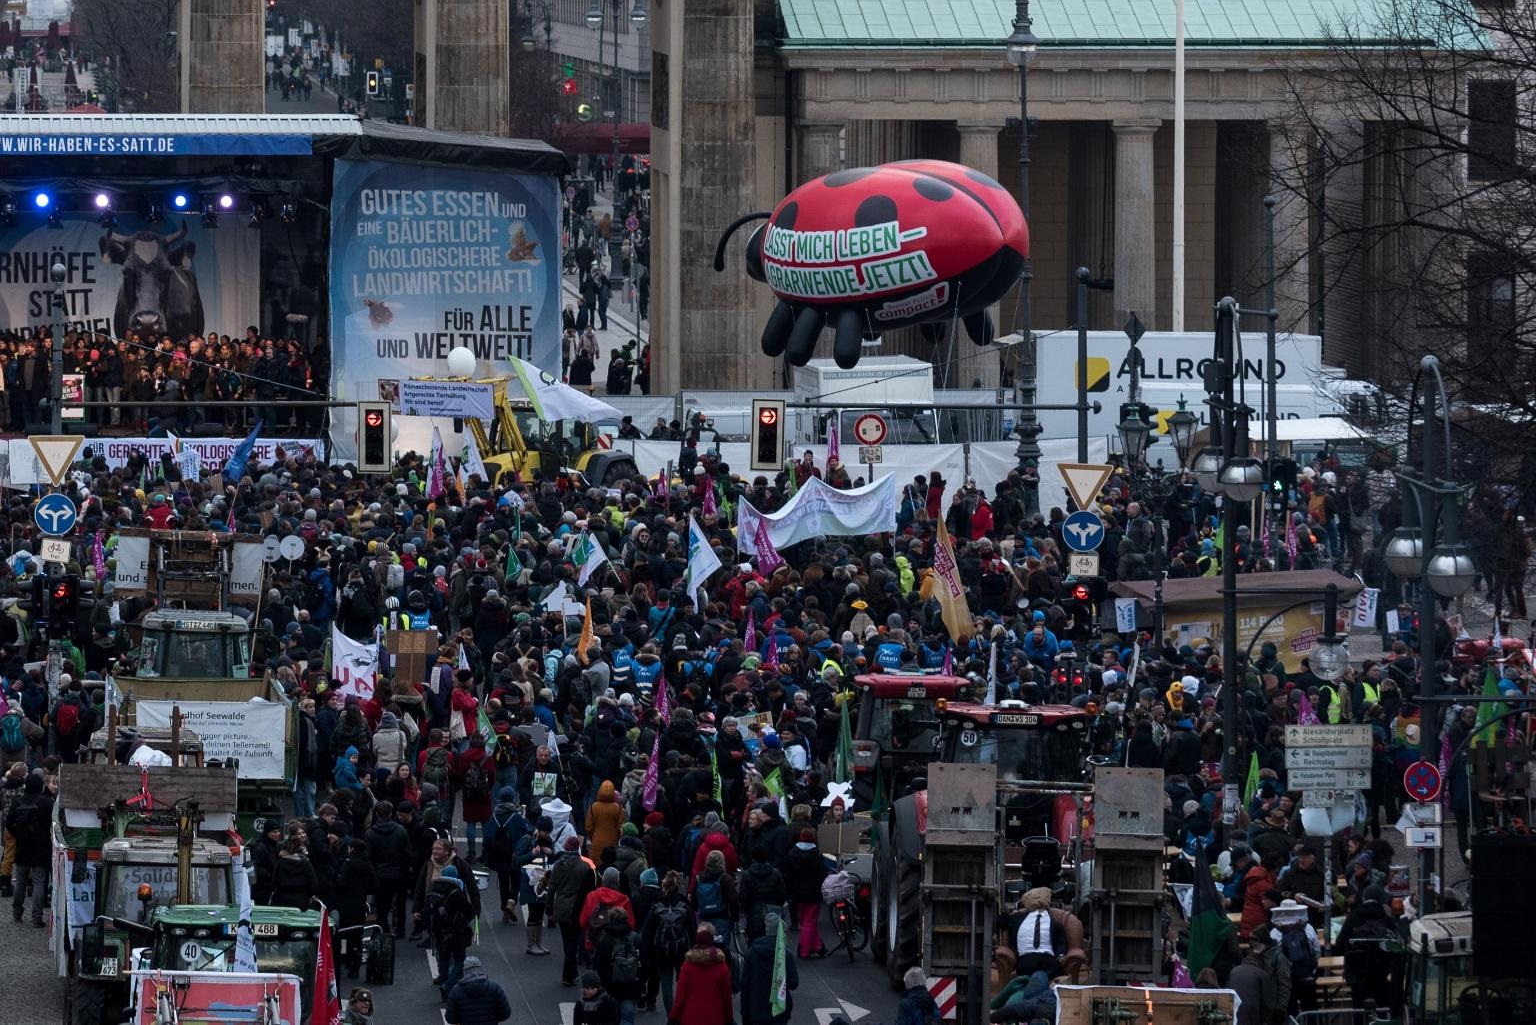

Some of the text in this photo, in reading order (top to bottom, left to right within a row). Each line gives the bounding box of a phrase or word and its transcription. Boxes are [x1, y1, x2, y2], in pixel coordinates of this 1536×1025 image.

[361, 189, 527, 218] GUTES ESSEN UND
[357, 217, 500, 244] EINE BÄUERLICH-
[797, 234, 833, 260] MICH
[838, 225, 898, 258] LEBEN
[368, 246, 501, 269] ÖKOLOGISCHERE
[864, 253, 933, 290] JETZT!
[353, 269, 532, 297] LANDWIRTSCHAFT!
[444, 305, 532, 332] FÜR ALLE
[376, 339, 409, 359] UND
[119, 574, 140, 583] und
[206, 711, 246, 720] Seewalde
[964, 732, 974, 743] 50
[1303, 728, 1355, 736] Alexanderplatz
[232, 741, 271, 749] Tellerrand!
[244, 750, 273, 758] Zukunft
[1303, 758, 1336, 766] Reichstag
[231, 925, 275, 934] K 488
[185, 945, 196, 958] 40
[102, 966, 117, 975] 673
